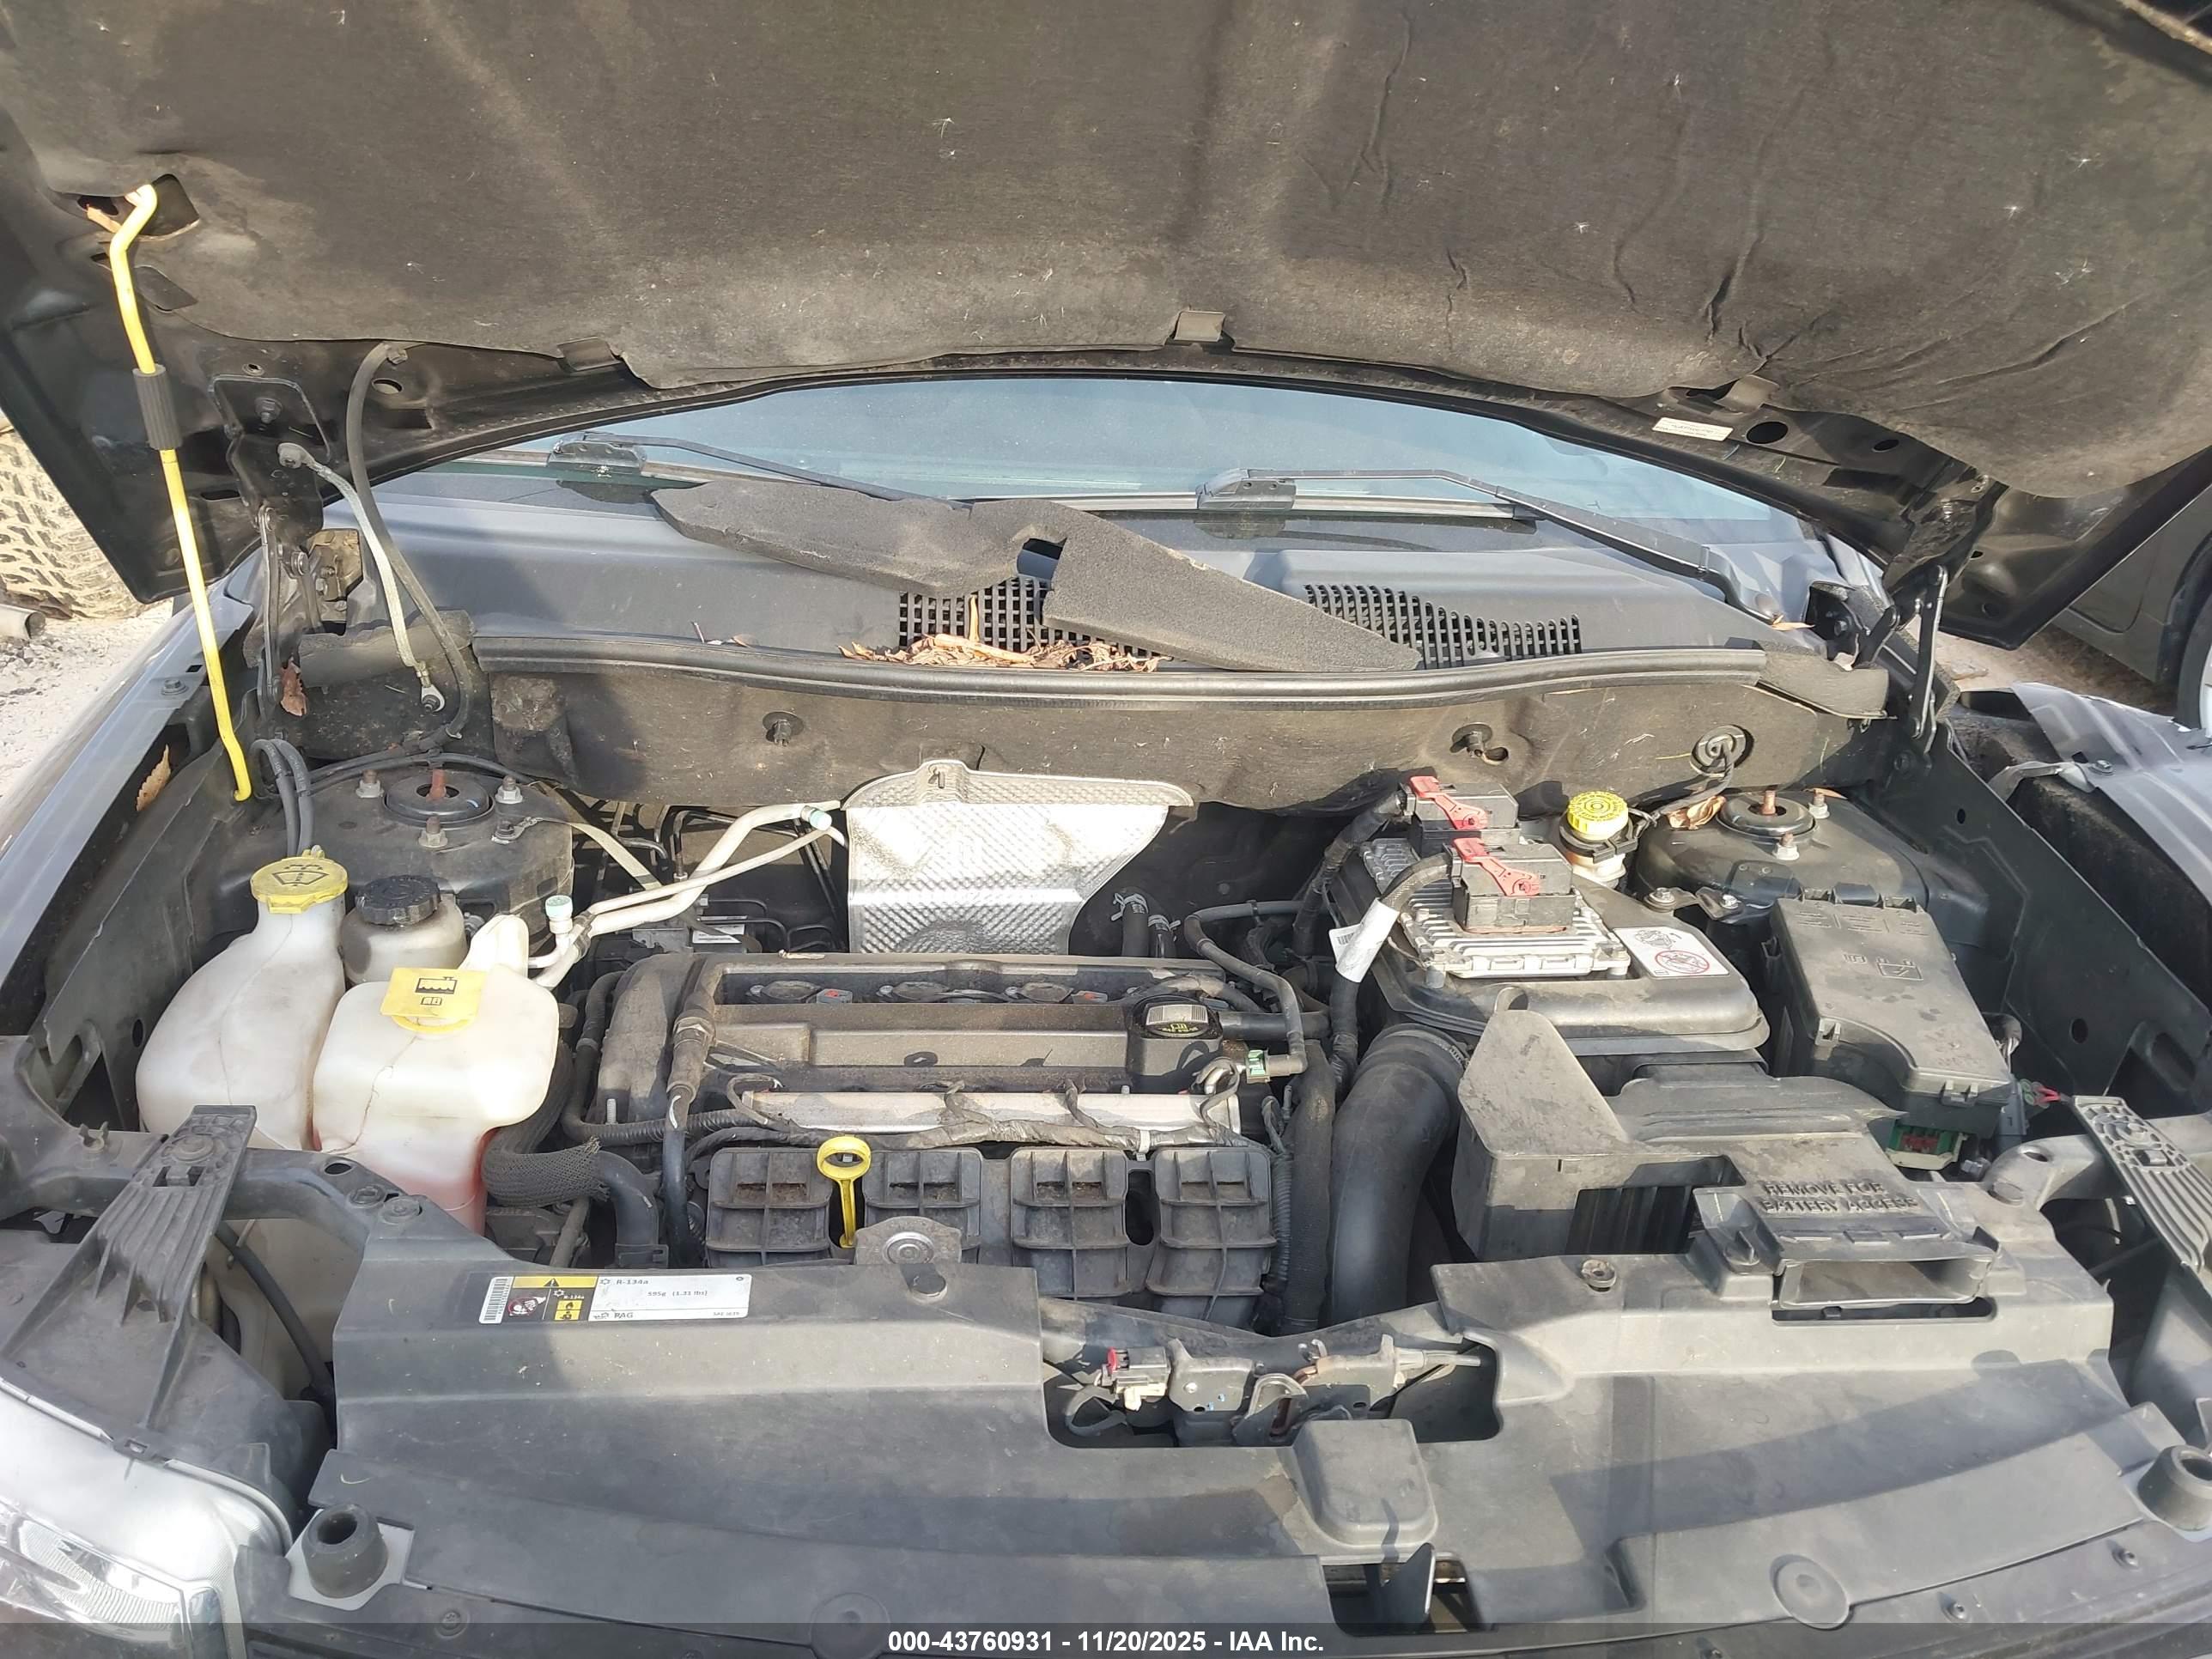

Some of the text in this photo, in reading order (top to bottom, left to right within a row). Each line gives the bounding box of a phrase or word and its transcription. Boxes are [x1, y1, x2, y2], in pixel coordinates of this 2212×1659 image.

[1763, 1180, 1885, 1196] REMOVE FOR
[1760, 1196, 1920, 1213] BATTERY ACCESS
